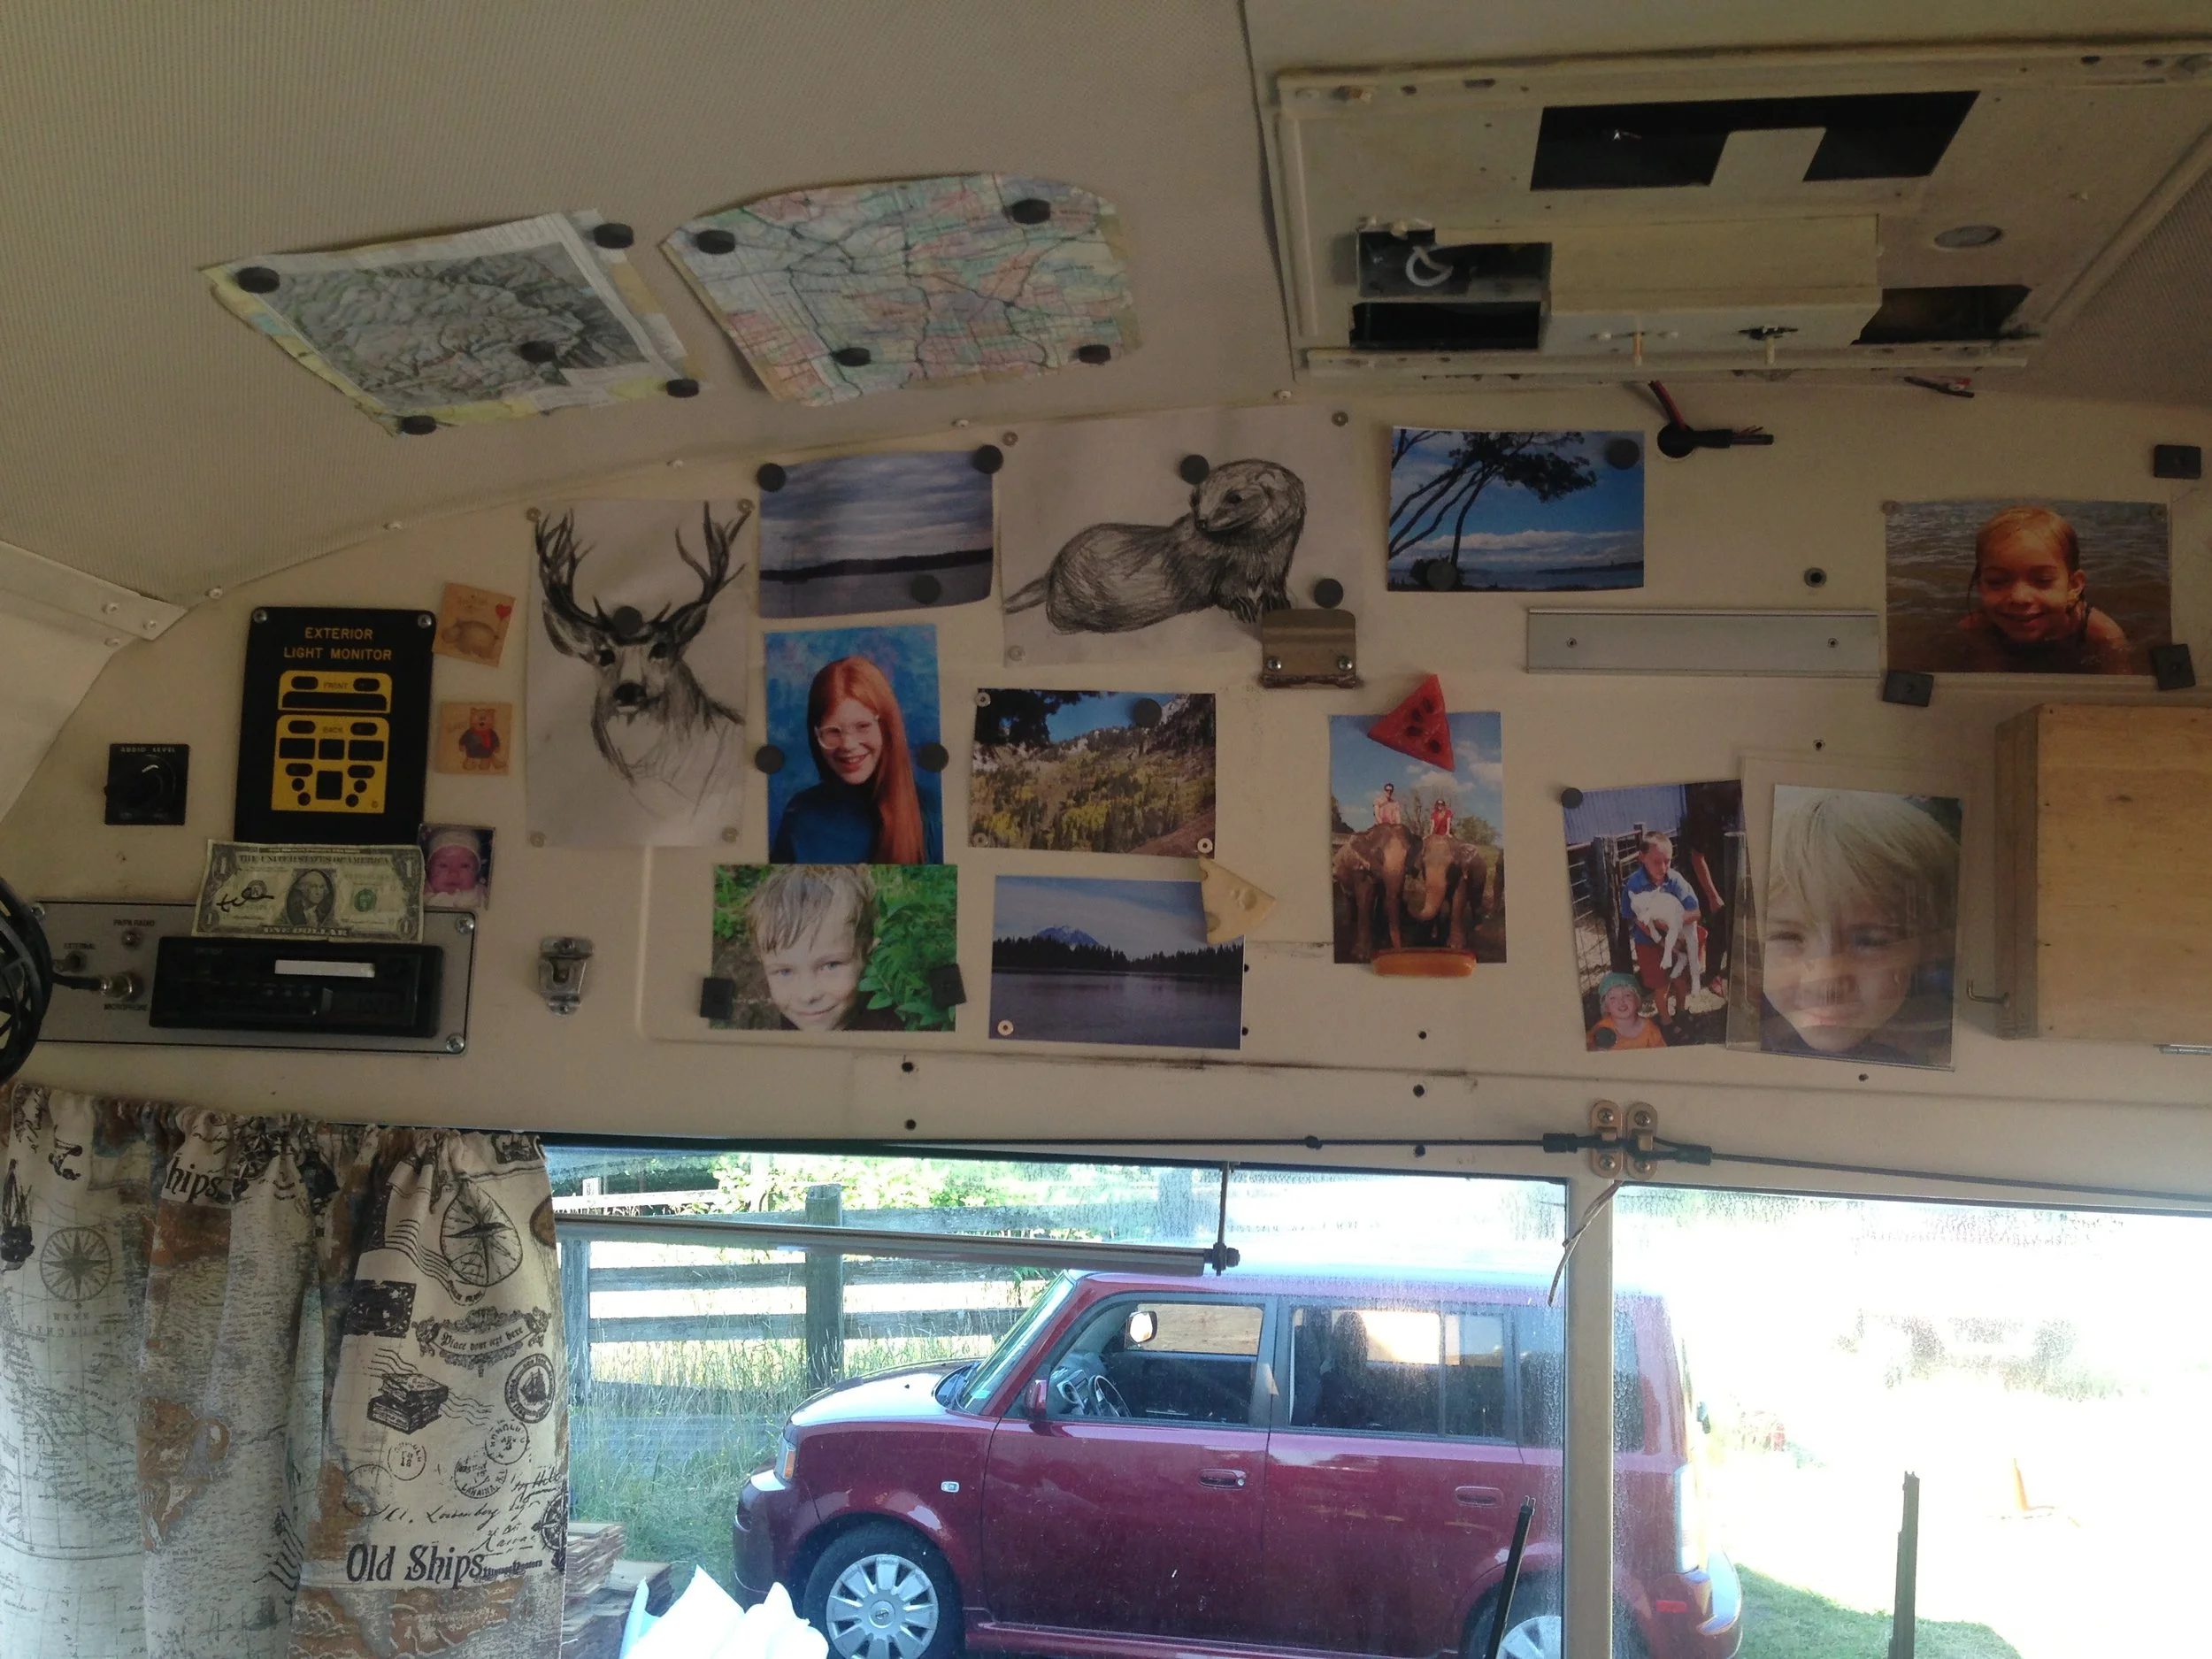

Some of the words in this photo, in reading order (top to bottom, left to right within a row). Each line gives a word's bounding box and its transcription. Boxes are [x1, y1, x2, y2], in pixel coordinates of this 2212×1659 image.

[304, 626, 373, 641] EXTERIOR
[283, 646, 324, 659] LIGHT
[330, 648, 393, 661] MONITOR
[240, 855, 257, 864] THE
[441, 1332, 466, 1350] Place
[346, 1542, 396, 1582] Old
[404, 1544, 486, 1590] Ships
